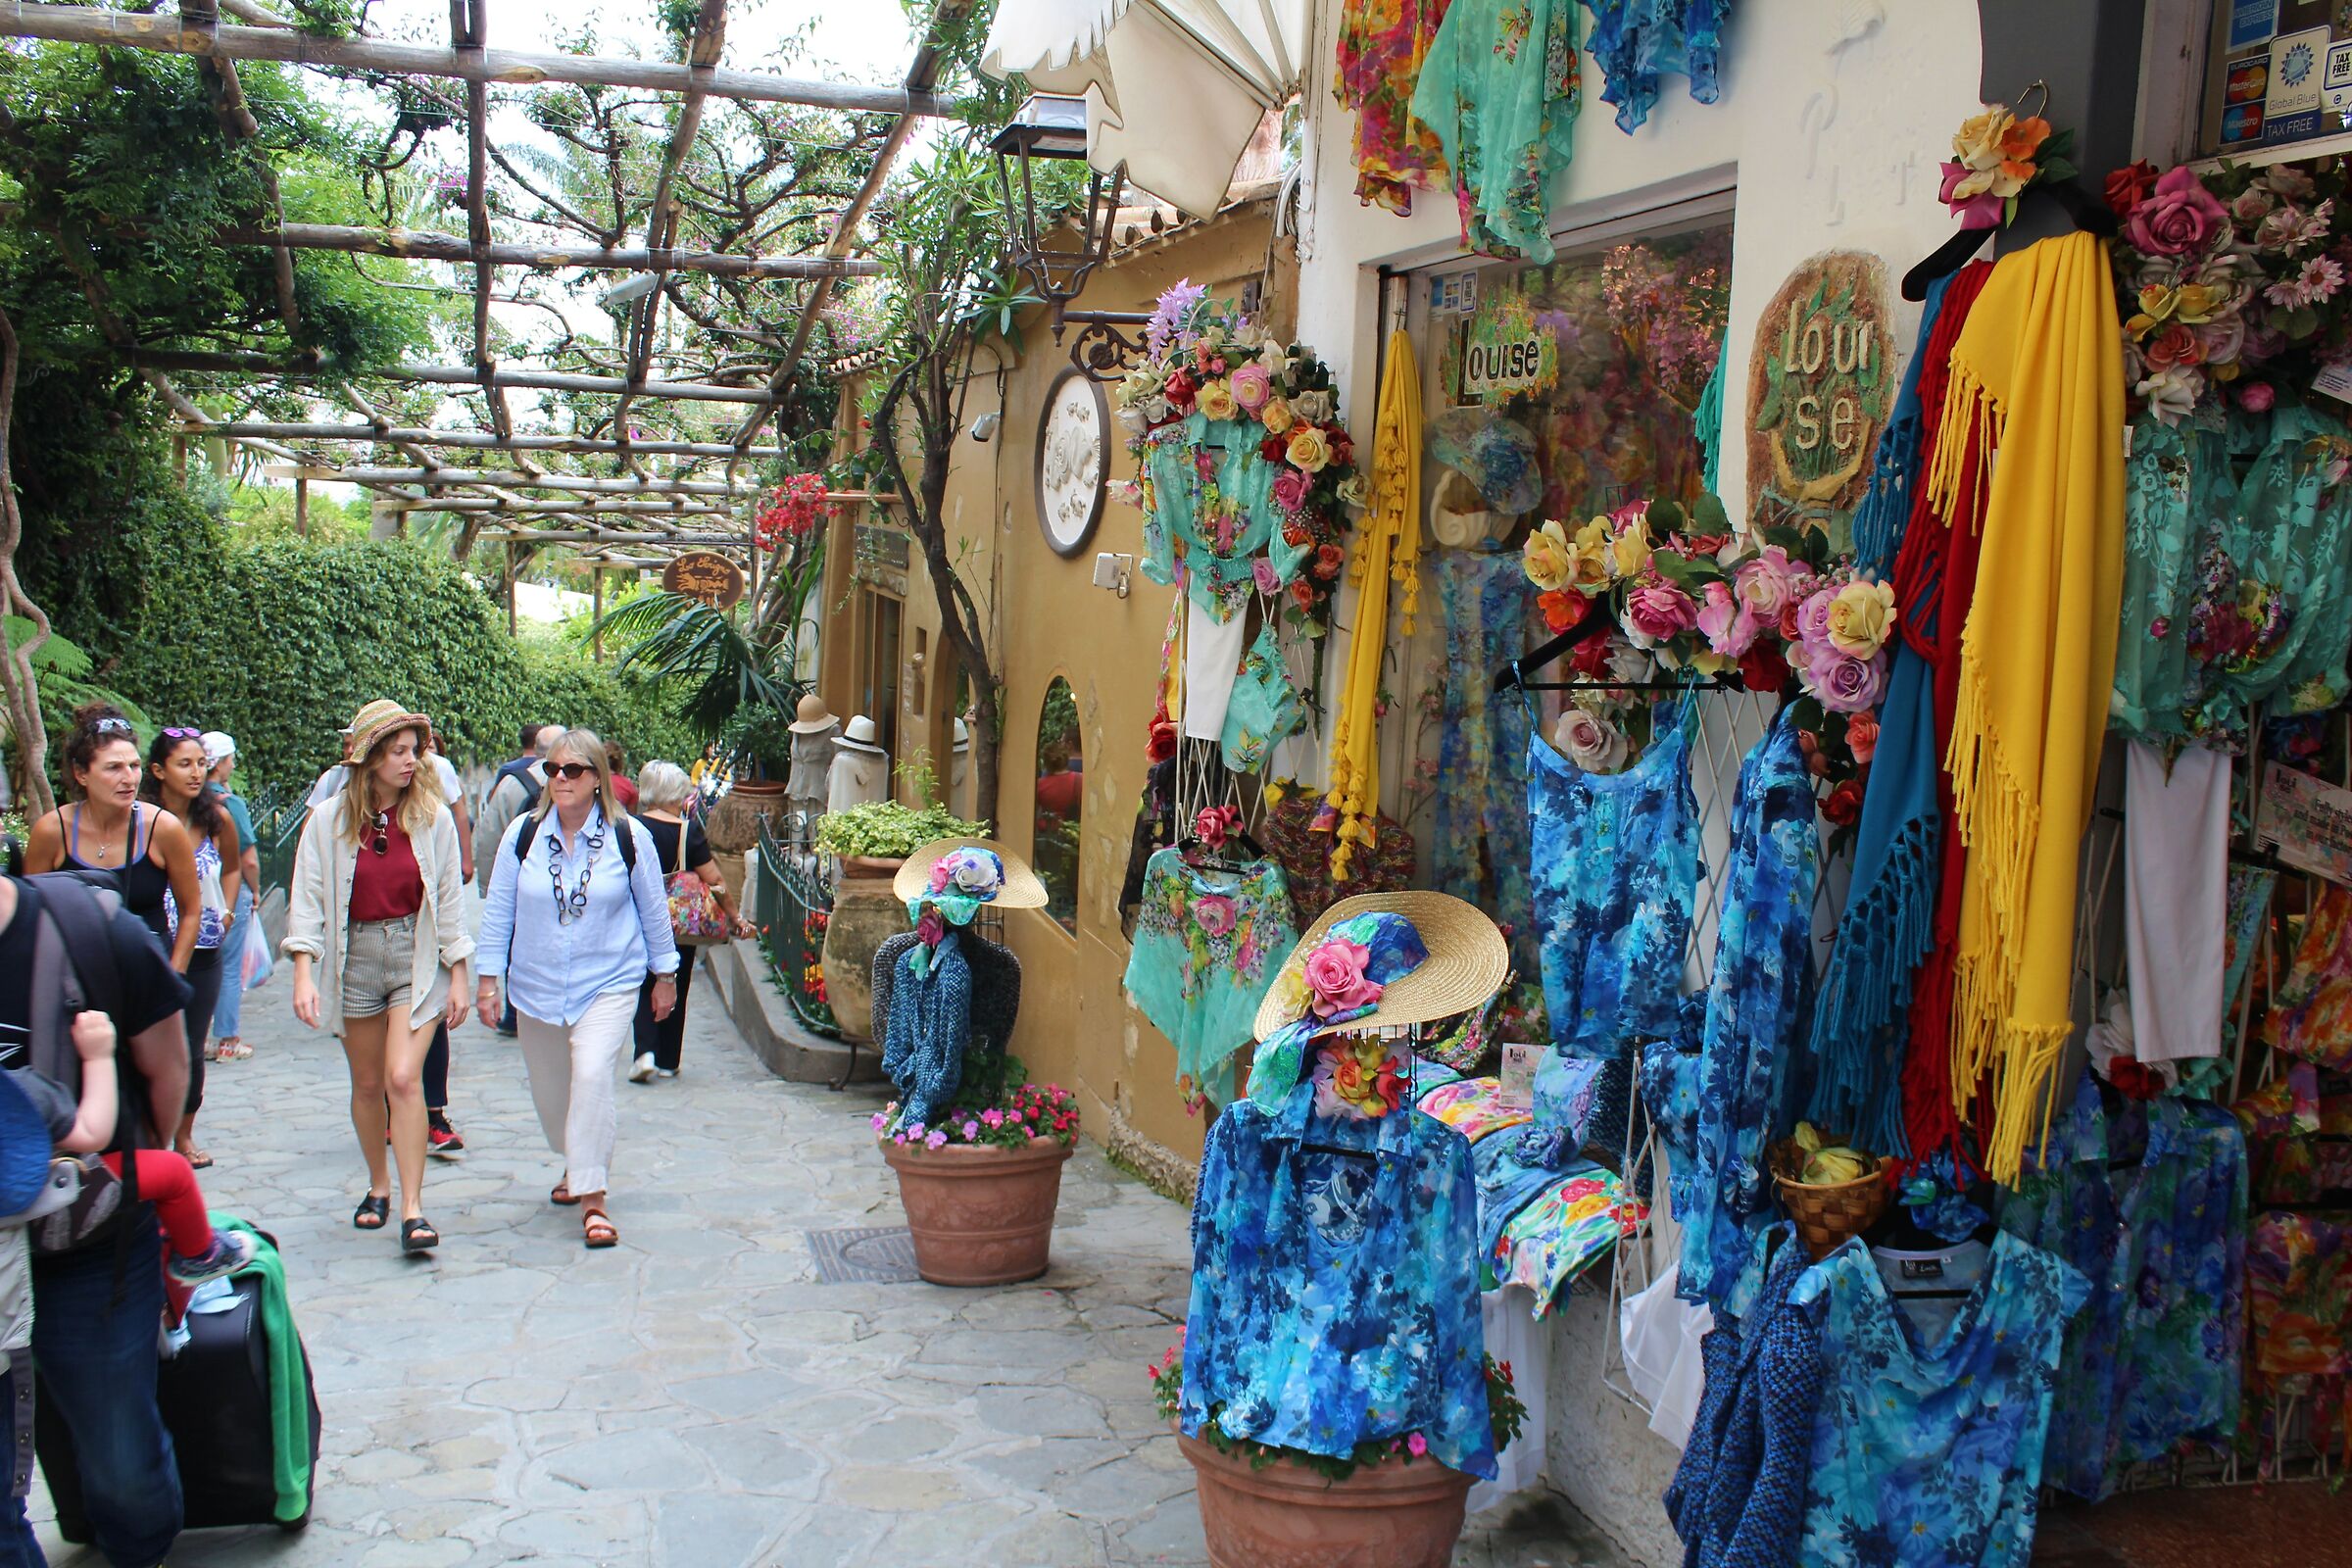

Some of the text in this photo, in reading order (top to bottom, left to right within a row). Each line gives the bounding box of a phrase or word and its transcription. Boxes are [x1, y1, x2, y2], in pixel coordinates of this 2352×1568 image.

[2335, 52, 2351, 65] TAX
[2332, 62, 2351, 74] FREE
[2269, 93, 2317, 111] Global Blue
[2267, 117, 2314, 138] TAX FREE
[1795, 395, 1854, 450] se
